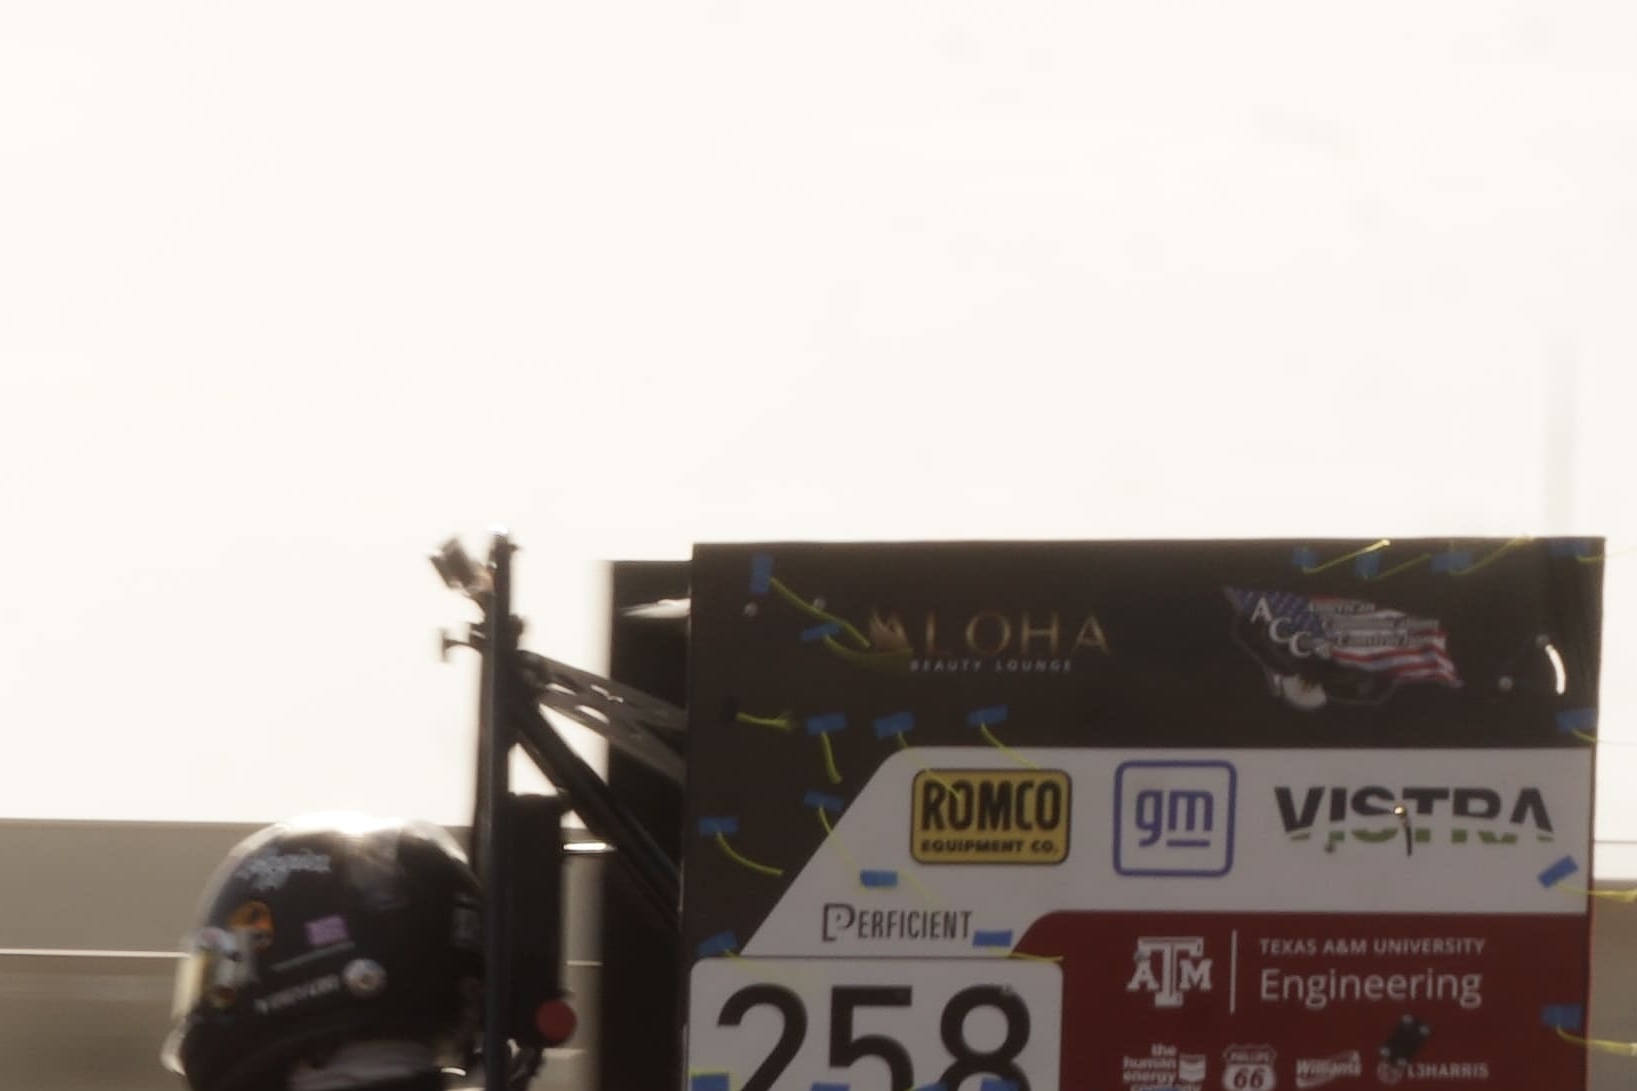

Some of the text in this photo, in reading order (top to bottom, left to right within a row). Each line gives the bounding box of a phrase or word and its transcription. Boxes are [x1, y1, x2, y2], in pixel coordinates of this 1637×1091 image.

[910, 661, 1072, 673] BEAUTY LOUNGE
[920, 779, 1062, 832] ROMCO
[1135, 789, 1214, 848] gm
[1274, 785, 1555, 844] VISTRA
[921, 839, 1060, 854] EQUIPMENT CO.
[822, 903, 973, 942] PERFICIENT
[1260, 938, 1485, 955] TEXAS A&M UNIVERSITY
[1261, 969, 1482, 1008] Engineering
[1151, 1043, 1177, 1057] the
[1123, 1055, 1177, 1069] human
[1407, 1062, 1490, 1079] L3HARRIS
[1123, 1070, 1177, 1085] energy
[1233, 1066, 1264, 1089] 66
